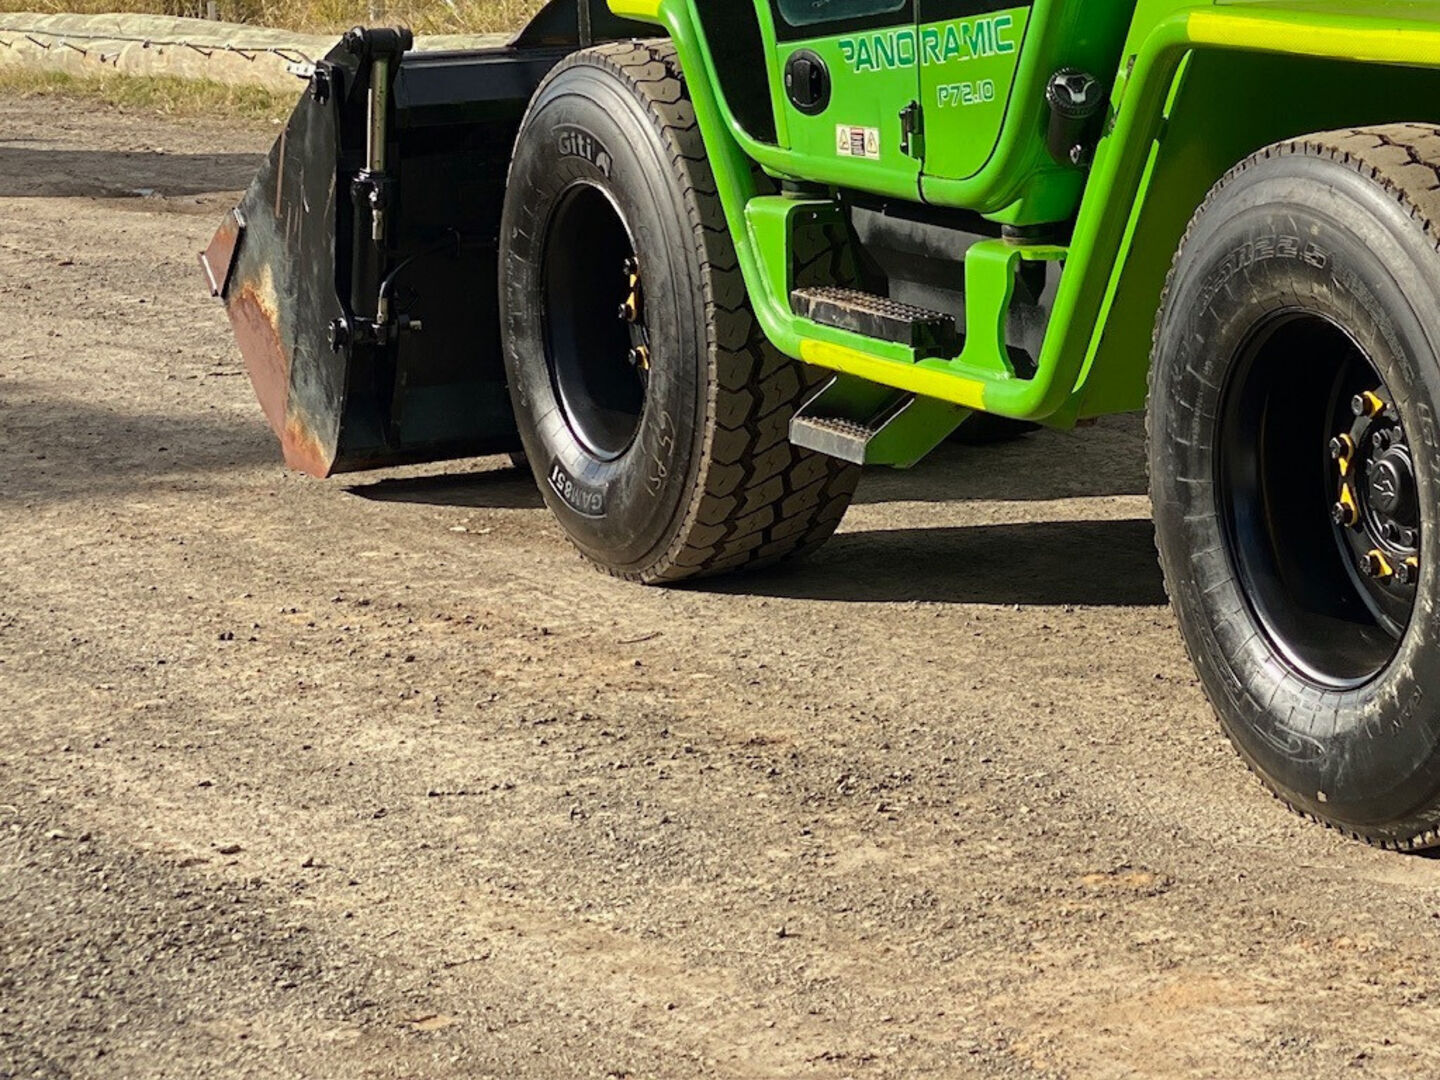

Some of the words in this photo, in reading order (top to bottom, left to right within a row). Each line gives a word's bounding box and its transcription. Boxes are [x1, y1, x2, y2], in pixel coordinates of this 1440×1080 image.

[838, 14, 1015, 74] PANORAMIC
[937, 78, 995, 109] P72.10
[559, 130, 593, 161] Giti
[551, 464, 603, 511] GAM851
